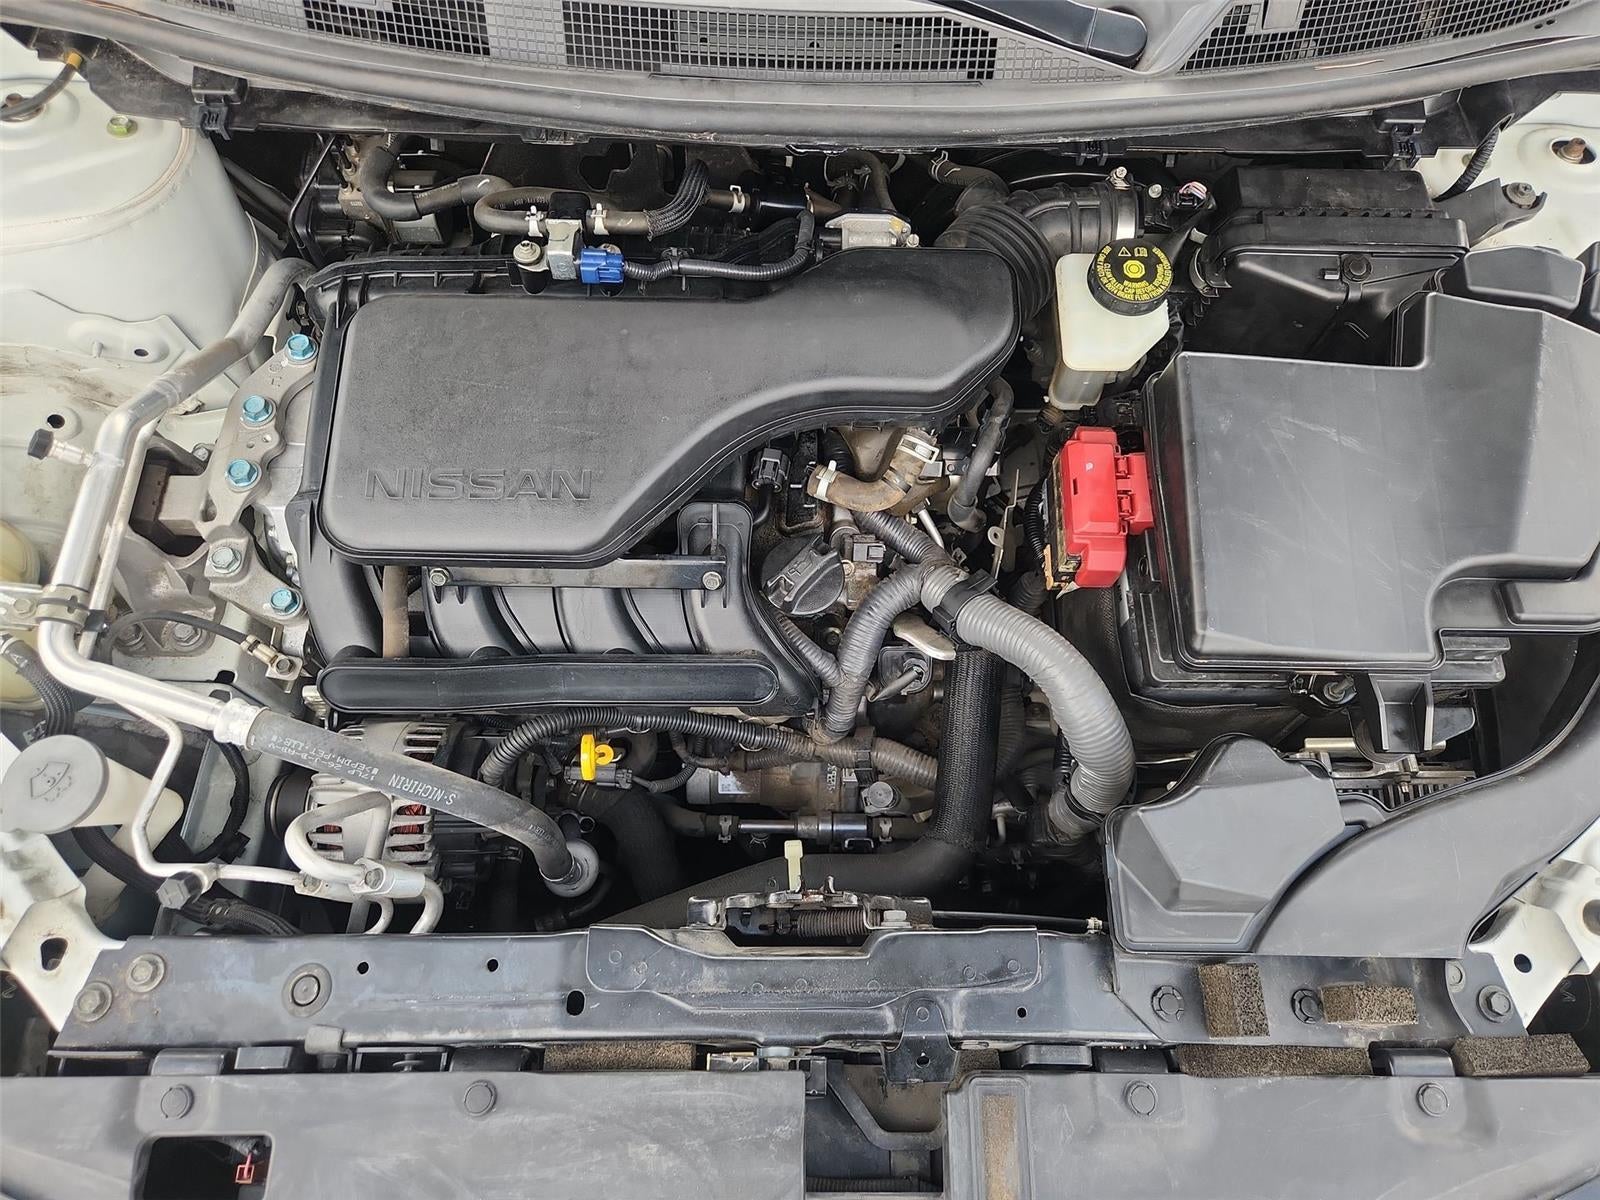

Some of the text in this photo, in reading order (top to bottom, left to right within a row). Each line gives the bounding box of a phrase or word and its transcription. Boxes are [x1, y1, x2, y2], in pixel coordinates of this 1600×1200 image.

[1097, 254, 1106, 265] ONLY
[1116, 290, 1134, 300] BRAKE
[1149, 287, 1164, 298] FROM
[1104, 263, 1112, 277] CLEAN
[1109, 277, 1124, 291] FILLER
[1124, 286, 1135, 294] CAP
[1136, 284, 1156, 294] BEFORE
[1124, 280, 1149, 288] WARNING
[366, 468, 592, 500] NISSAN
